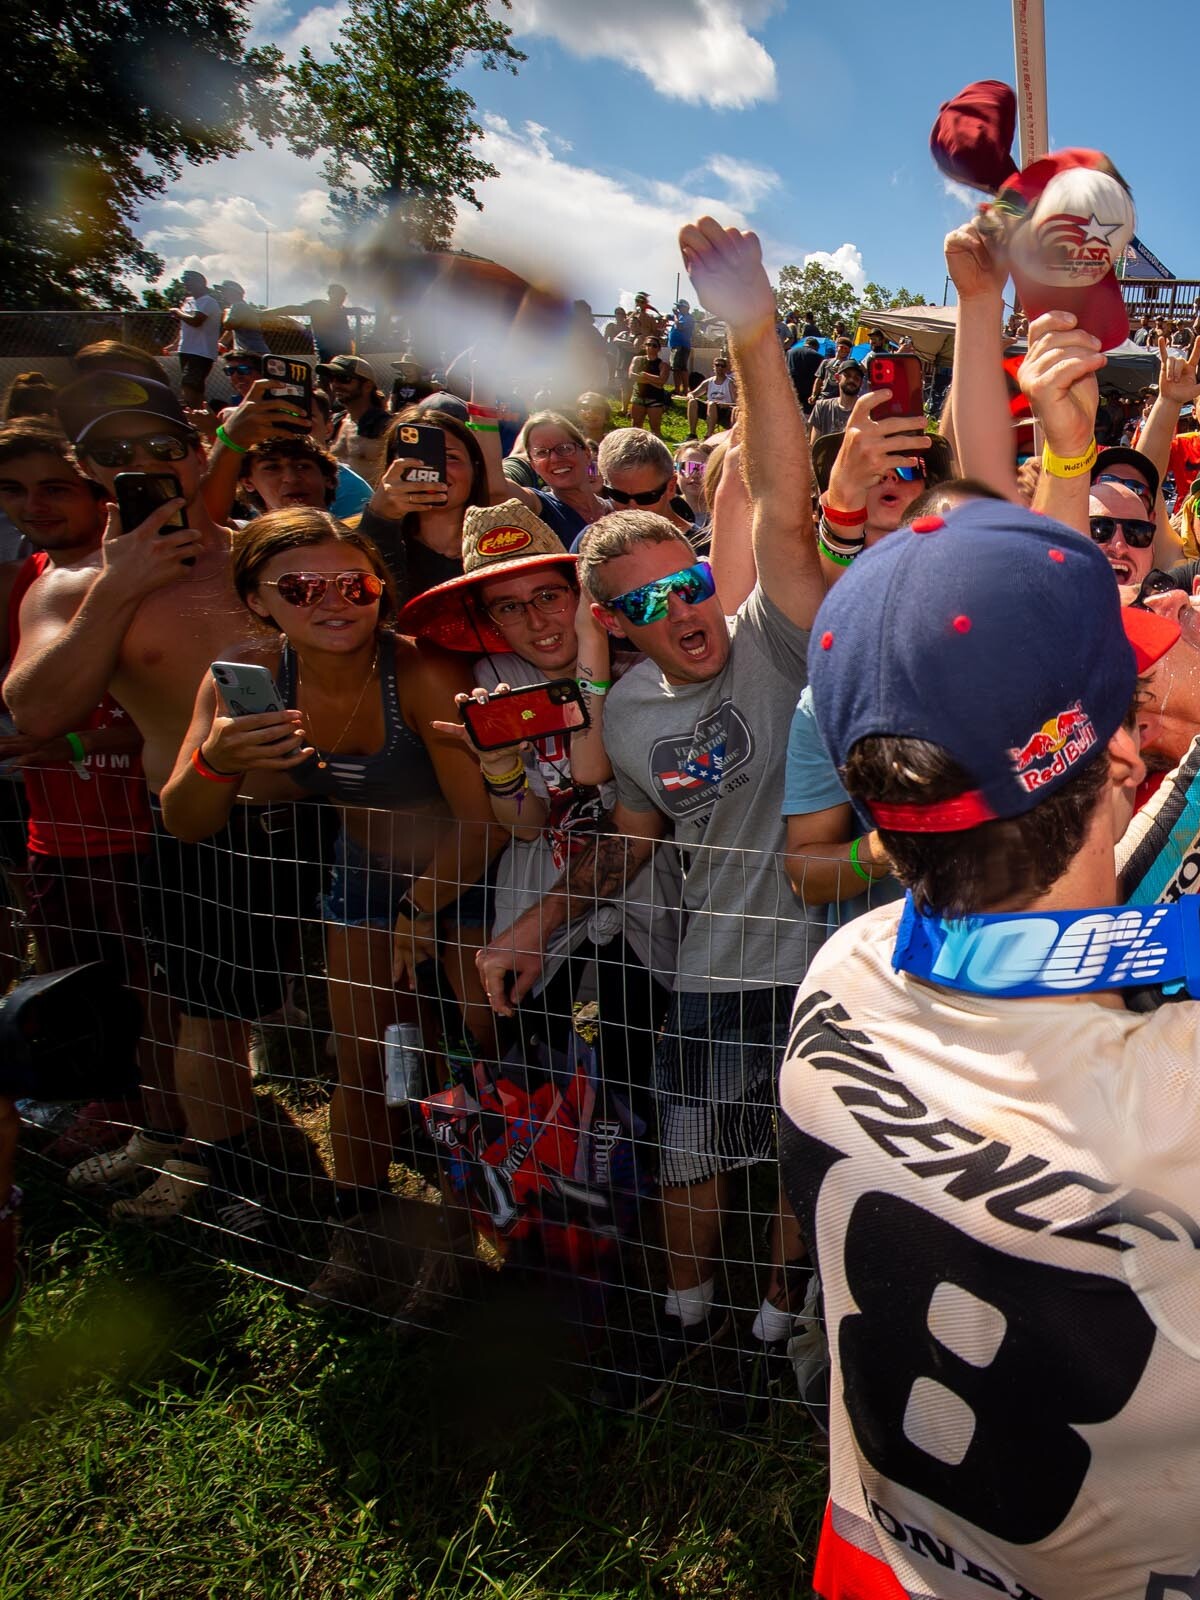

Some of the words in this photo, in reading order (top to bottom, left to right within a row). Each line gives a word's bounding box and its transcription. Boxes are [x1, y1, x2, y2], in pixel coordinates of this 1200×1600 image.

[482, 530, 525, 552] FMF
[724, 773, 750, 793] 338
[1017, 756, 1066, 794] Red
[1063, 718, 1099, 768] Bull
[931, 908, 1169, 990] 100%
[837, 1190, 1158, 1546] 8
